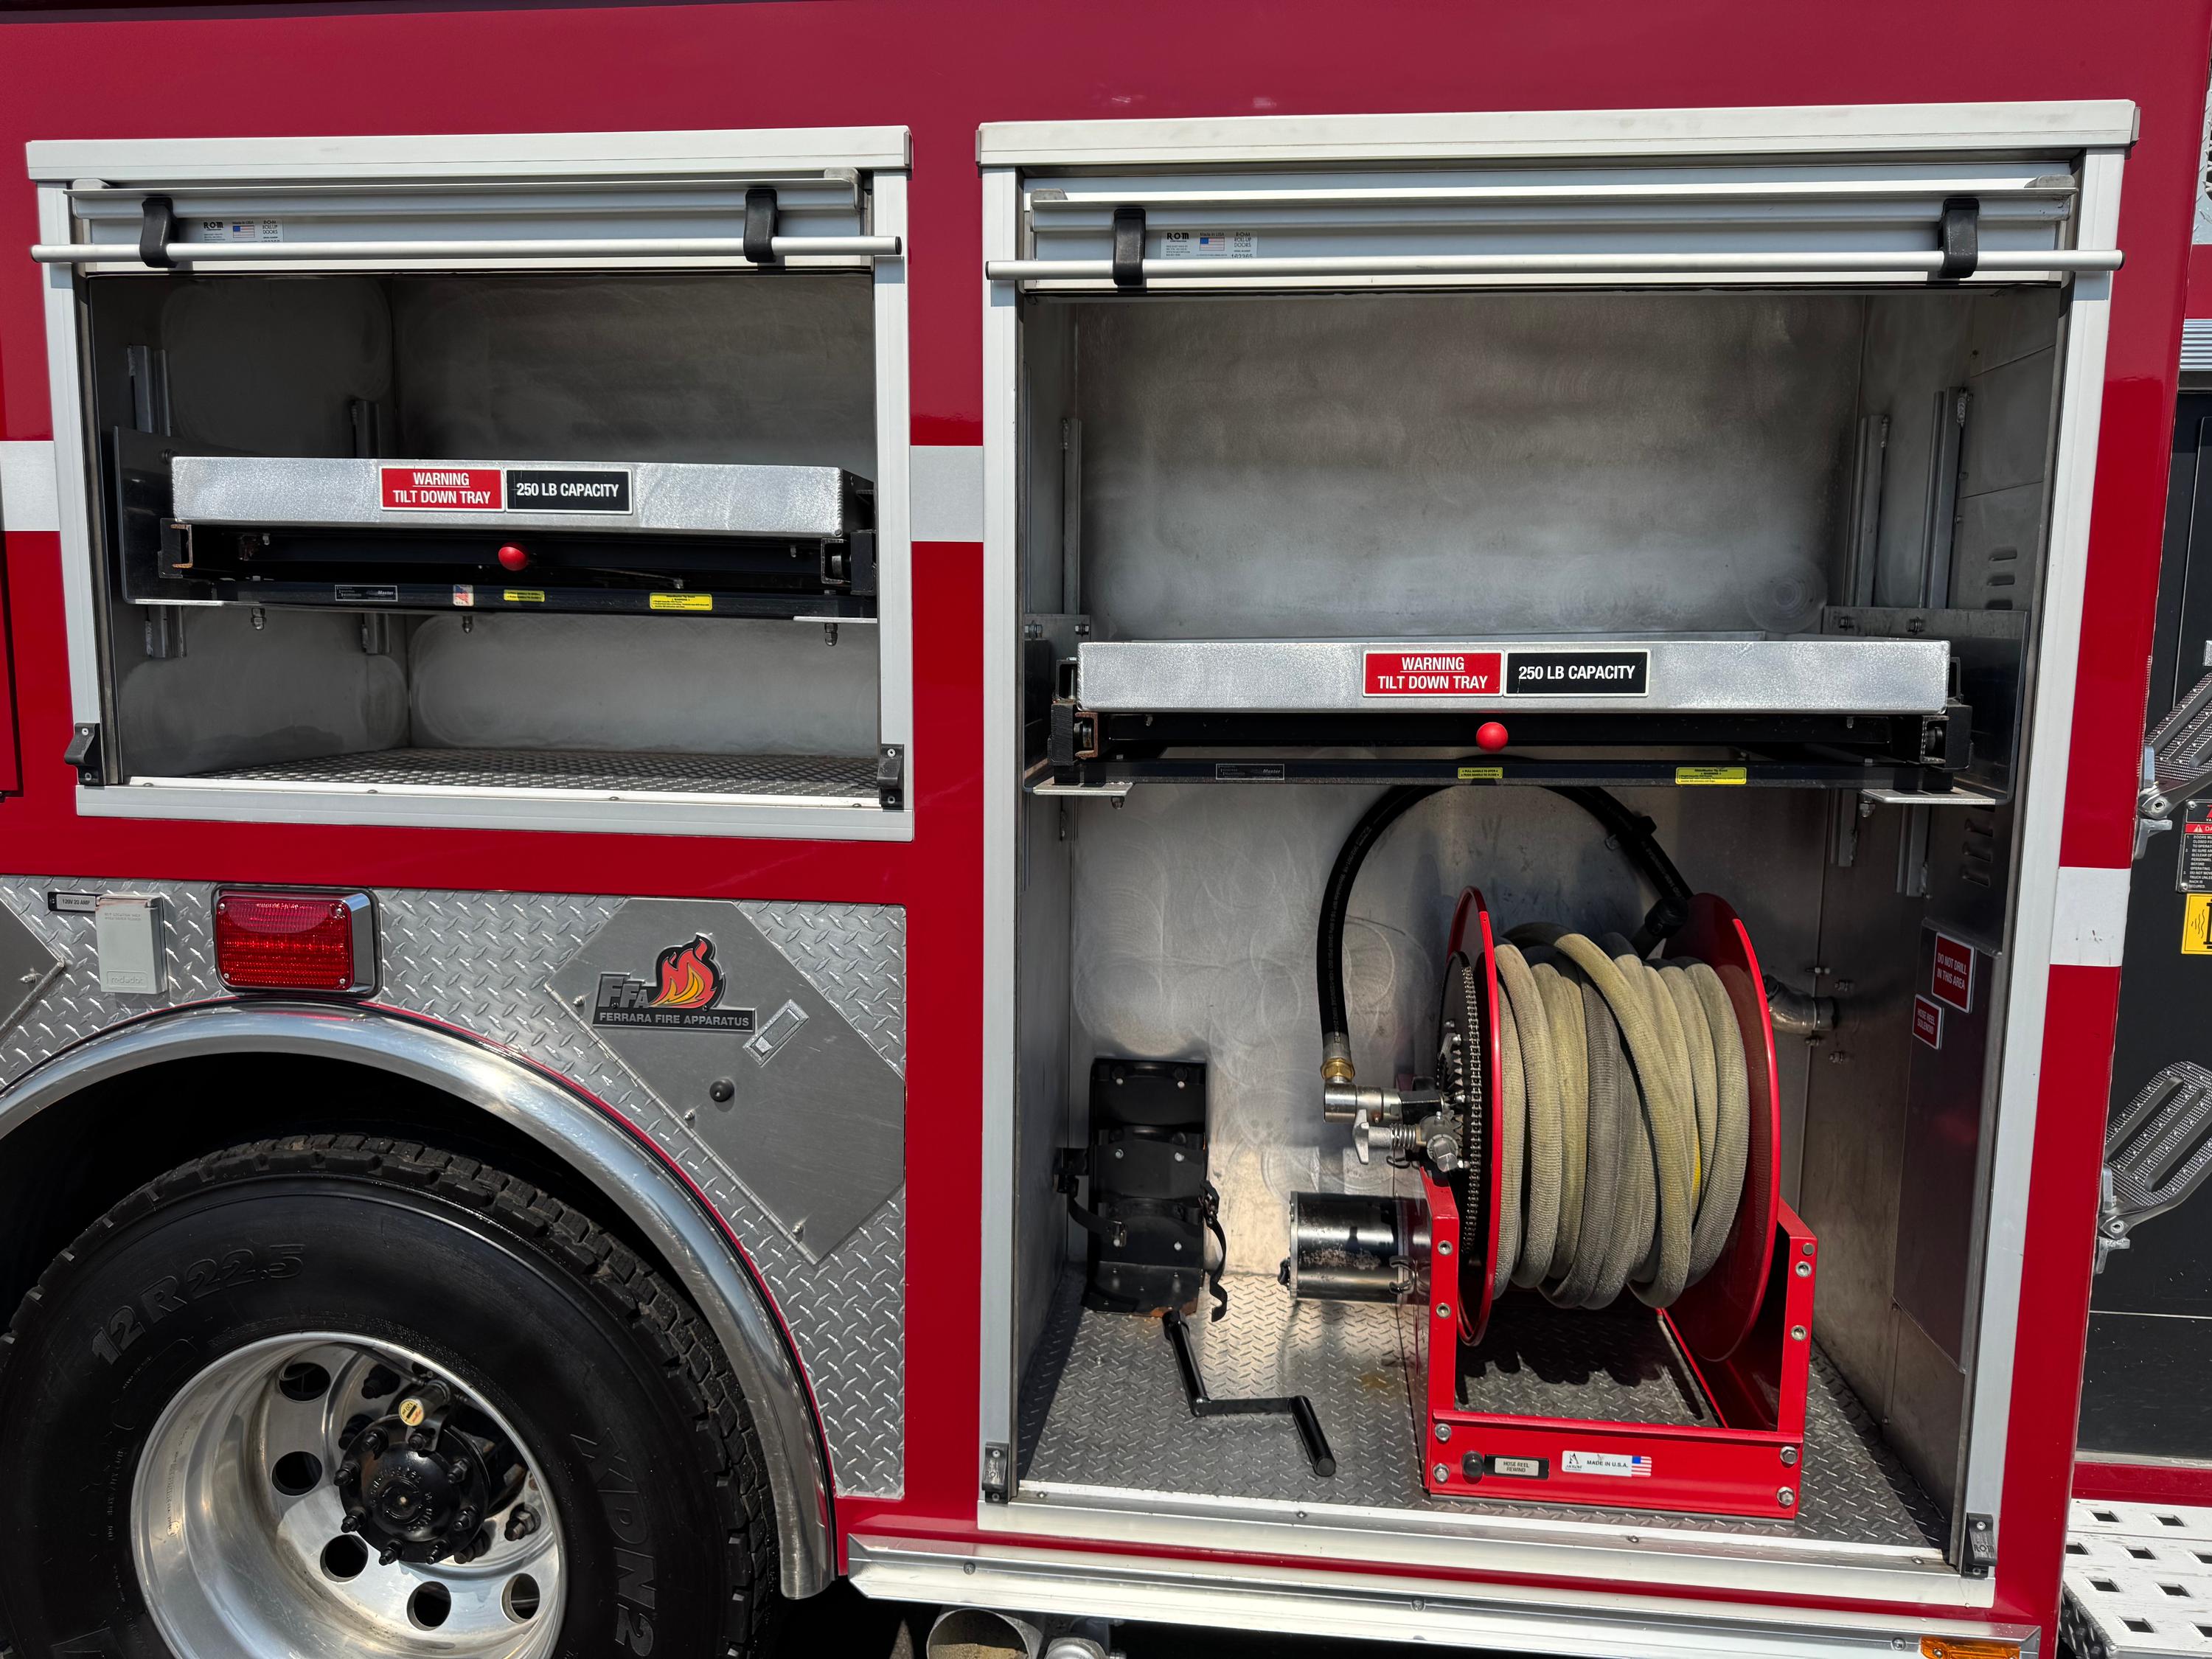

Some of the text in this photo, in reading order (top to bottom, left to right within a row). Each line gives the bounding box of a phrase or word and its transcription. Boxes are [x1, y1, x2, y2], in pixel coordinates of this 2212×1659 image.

[413, 472, 470, 486] WARNING
[393, 490, 491, 504] TILT DOWN TRAY
[516, 483, 619, 498] 250 LB CAPACITY
[1401, 656, 1464, 670] WARNING
[1518, 665, 1636, 681] 250 LB CAPACITY
[1377, 675, 1488, 689] TILT DOWN TRAY
[1937, 953, 1966, 975] DO NOT DRILL
[1937, 968, 1965, 990] IN THIS AREA
[599, 1012, 749, 1026] FERRARA FIRE APPARATUS
